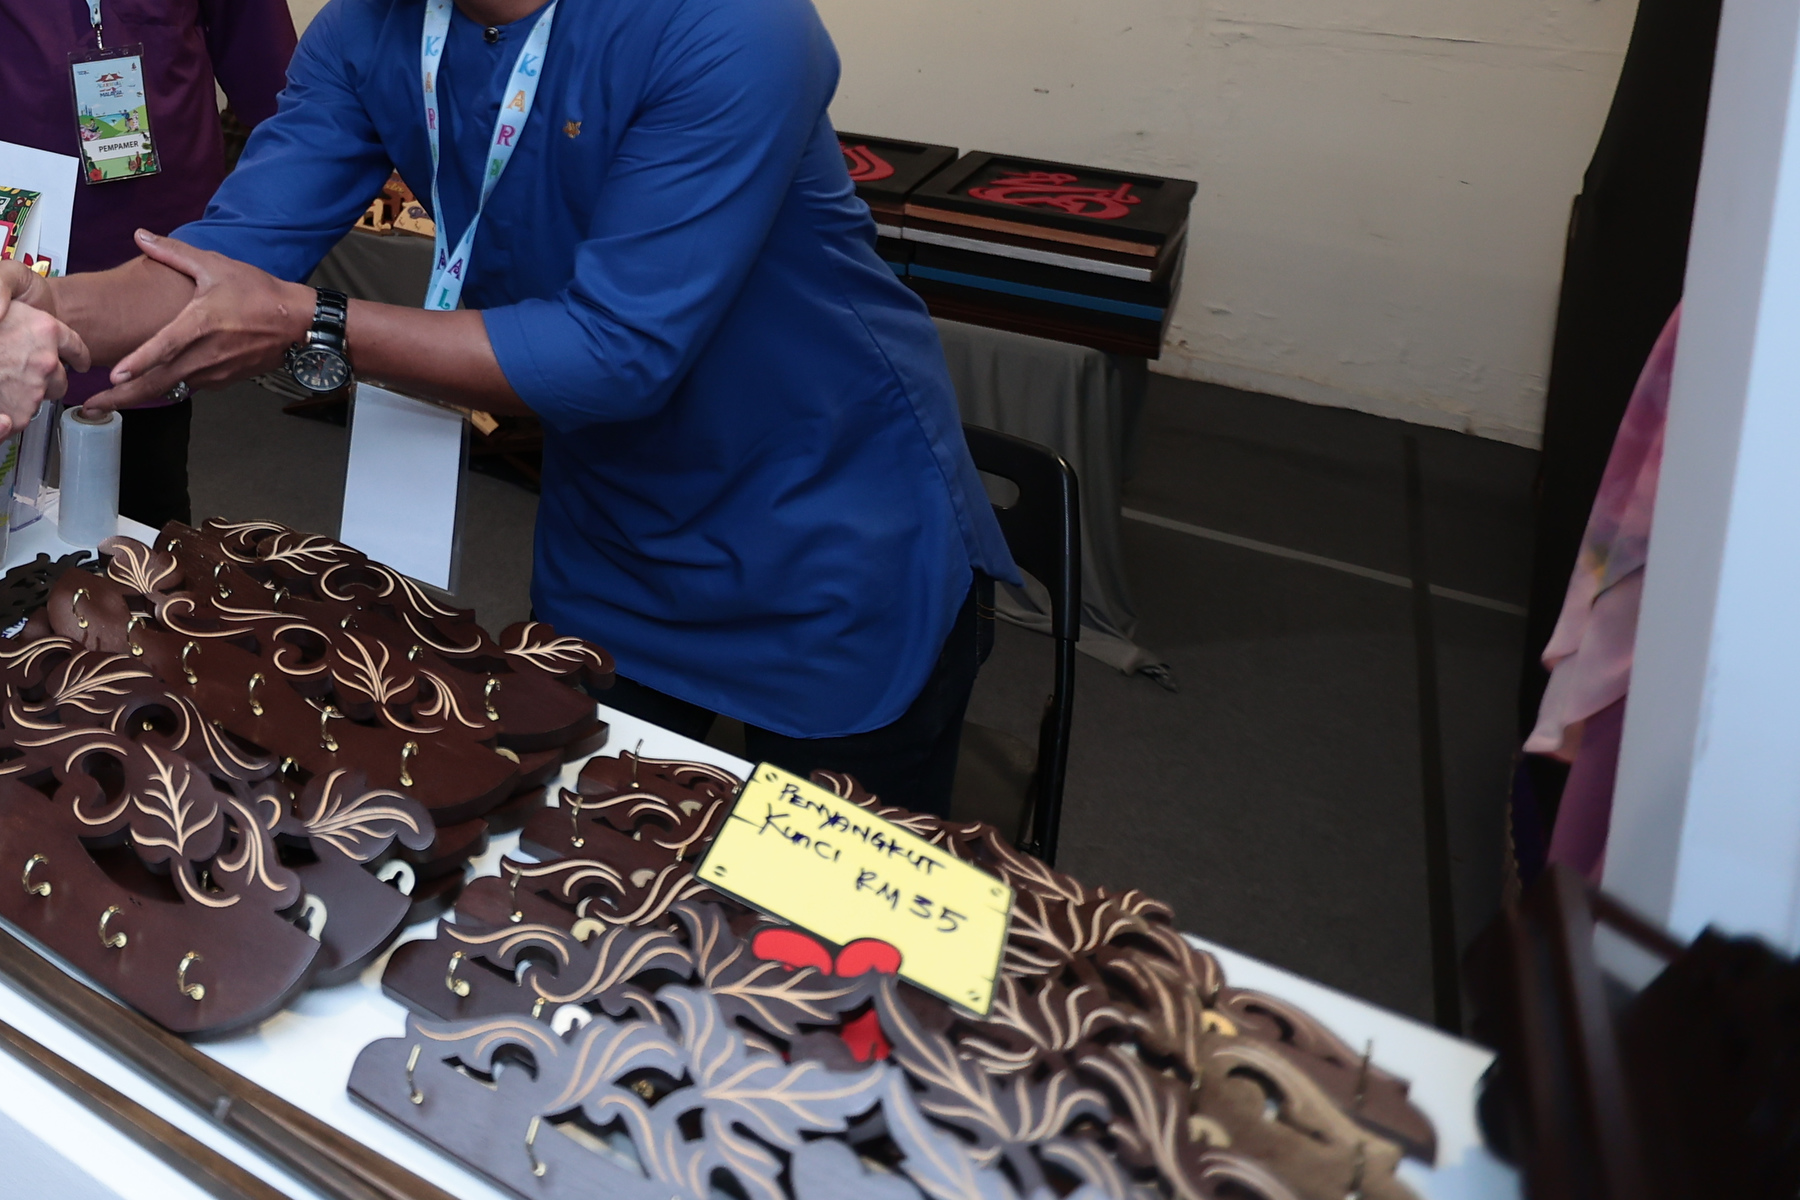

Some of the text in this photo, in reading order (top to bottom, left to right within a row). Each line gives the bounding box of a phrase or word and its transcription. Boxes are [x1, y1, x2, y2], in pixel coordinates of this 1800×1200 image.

[98, 140, 139, 153] PEMPAMER
[778, 782, 946, 876] PENYANGKUT
[855, 867, 901, 911] RM
[908, 894, 968, 933] 35
